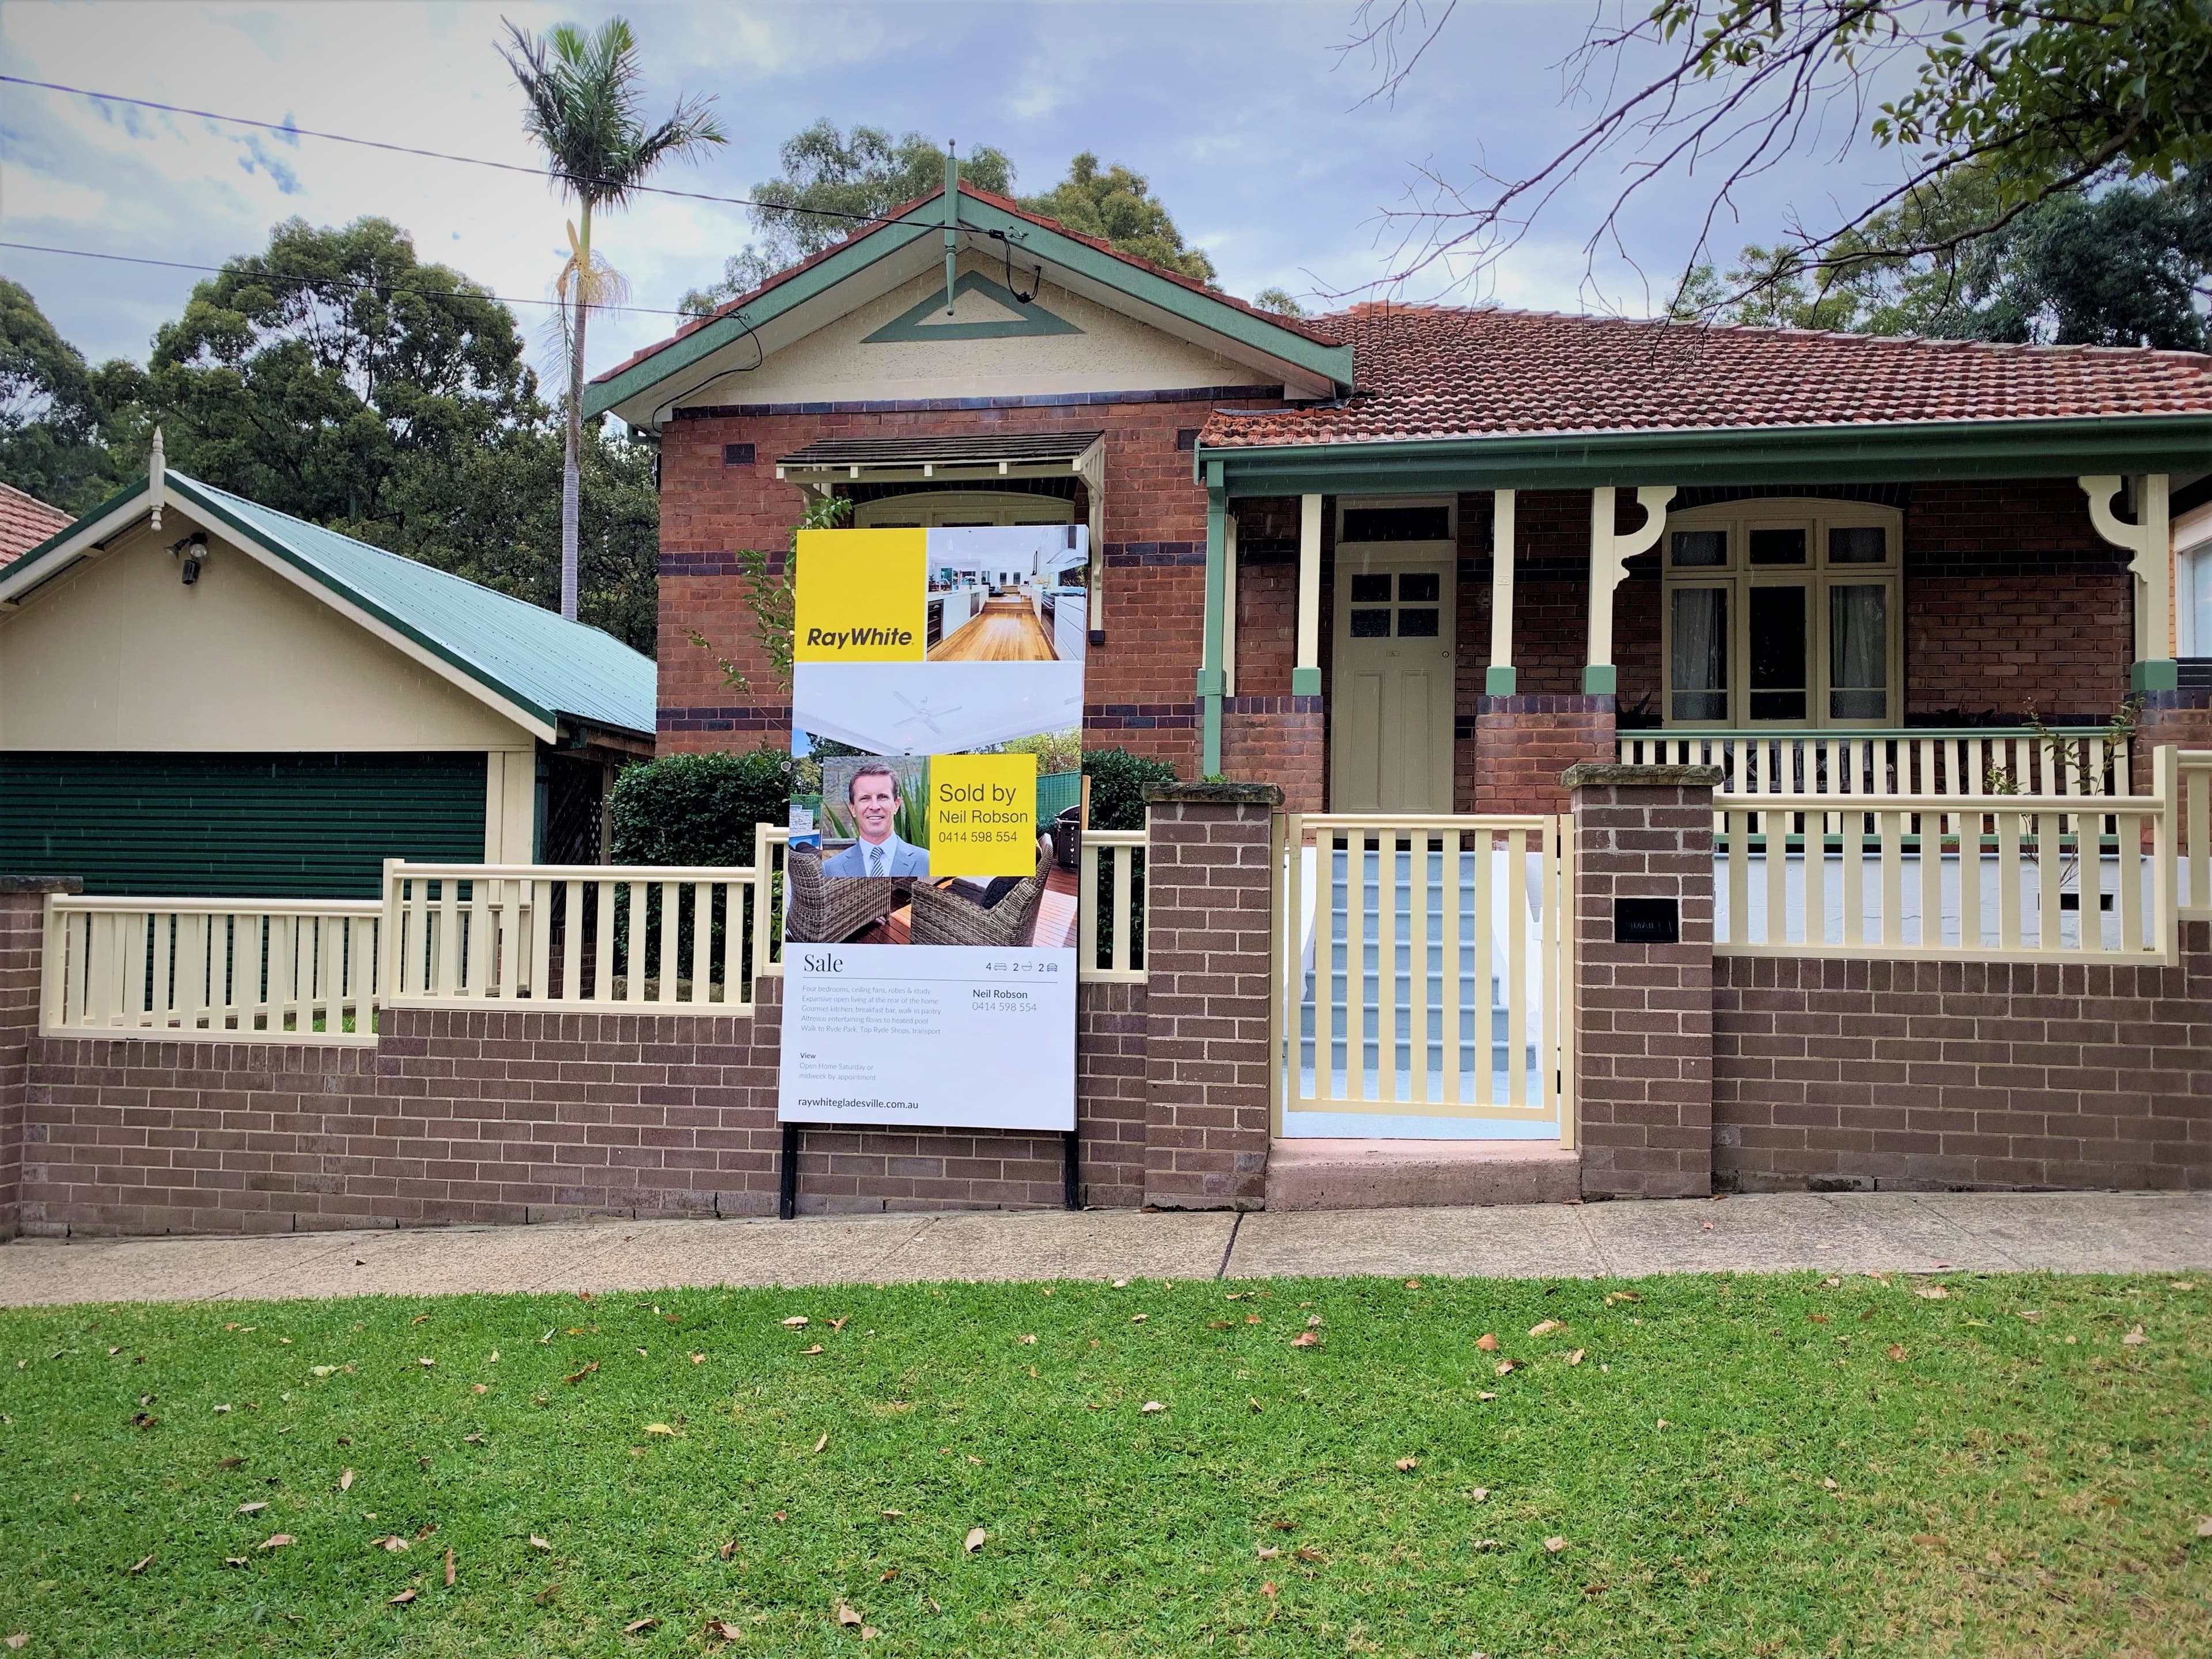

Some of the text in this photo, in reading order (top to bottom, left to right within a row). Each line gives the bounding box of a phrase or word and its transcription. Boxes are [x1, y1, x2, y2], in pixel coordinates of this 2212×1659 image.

[940, 783, 1016, 806] Sold by
[940, 810, 1028, 823] Neil Robson
[939, 831, 1017, 842] 0414 598 554
[804, 953, 843, 972] Sale
[986, 963, 1044, 972] 4 2 2
[973, 989, 1028, 999] Neil Robson
[972, 1002, 1037, 1012] 0414 598 554
[798, 1097, 919, 1109] raywhitegladesville.com.au
